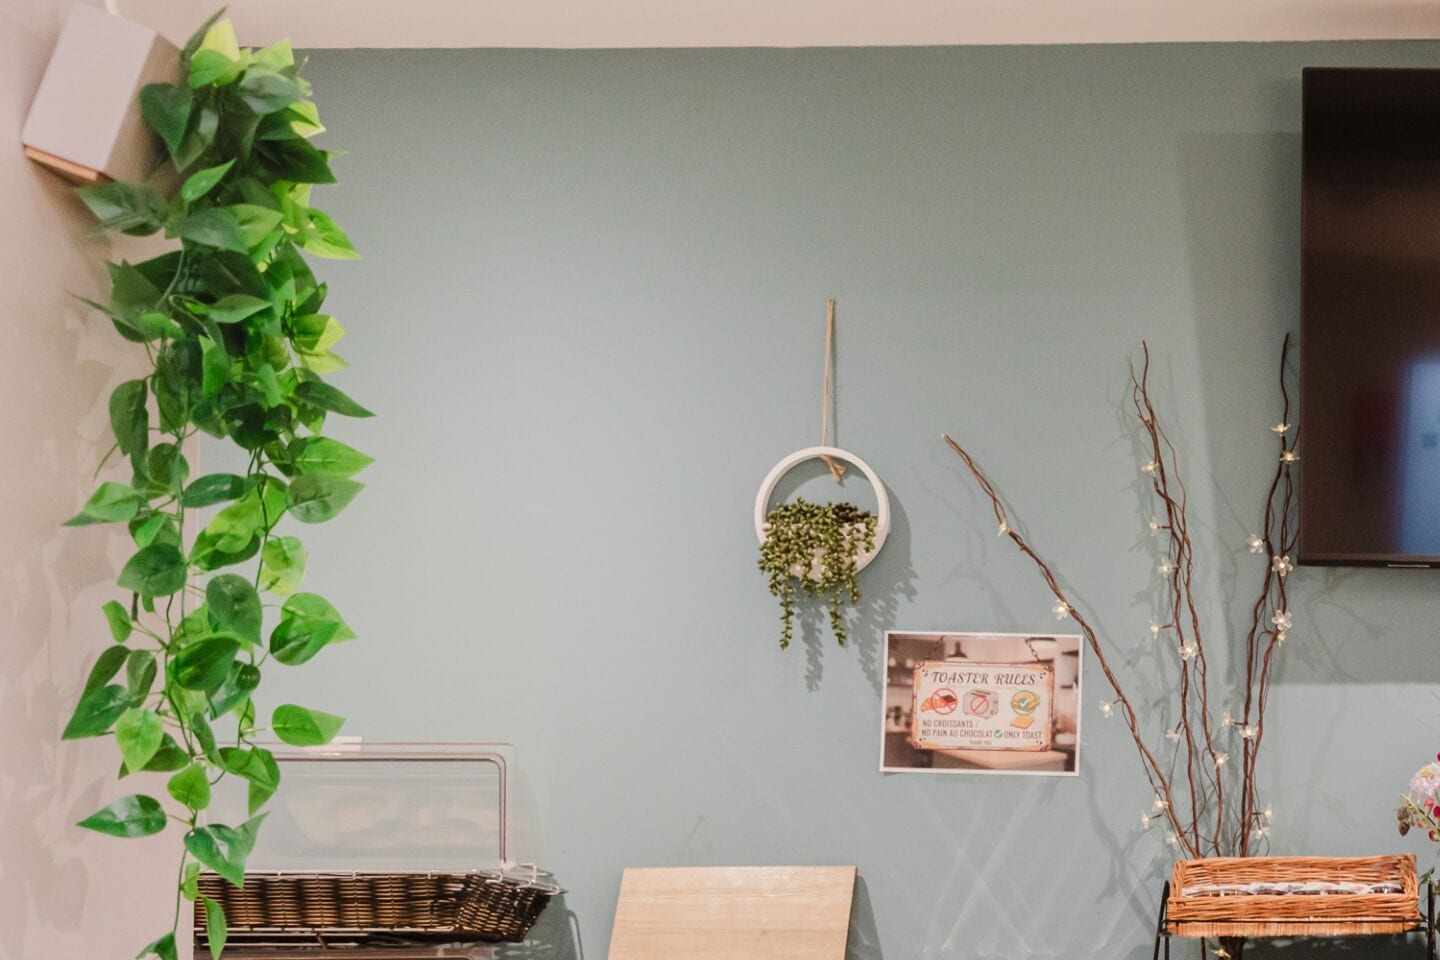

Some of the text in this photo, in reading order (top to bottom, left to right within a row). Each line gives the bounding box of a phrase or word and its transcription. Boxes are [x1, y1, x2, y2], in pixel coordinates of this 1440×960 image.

[932, 671, 1036, 685] TOASTER RULES
[922, 720, 931, 728] NO
[933, 720, 974, 728] CROISSANTS
[921, 729, 931, 737] NO
[960, 730, 993, 738] CHOCOLAT
[1004, 731, 1042, 739] ONLY TOAST
